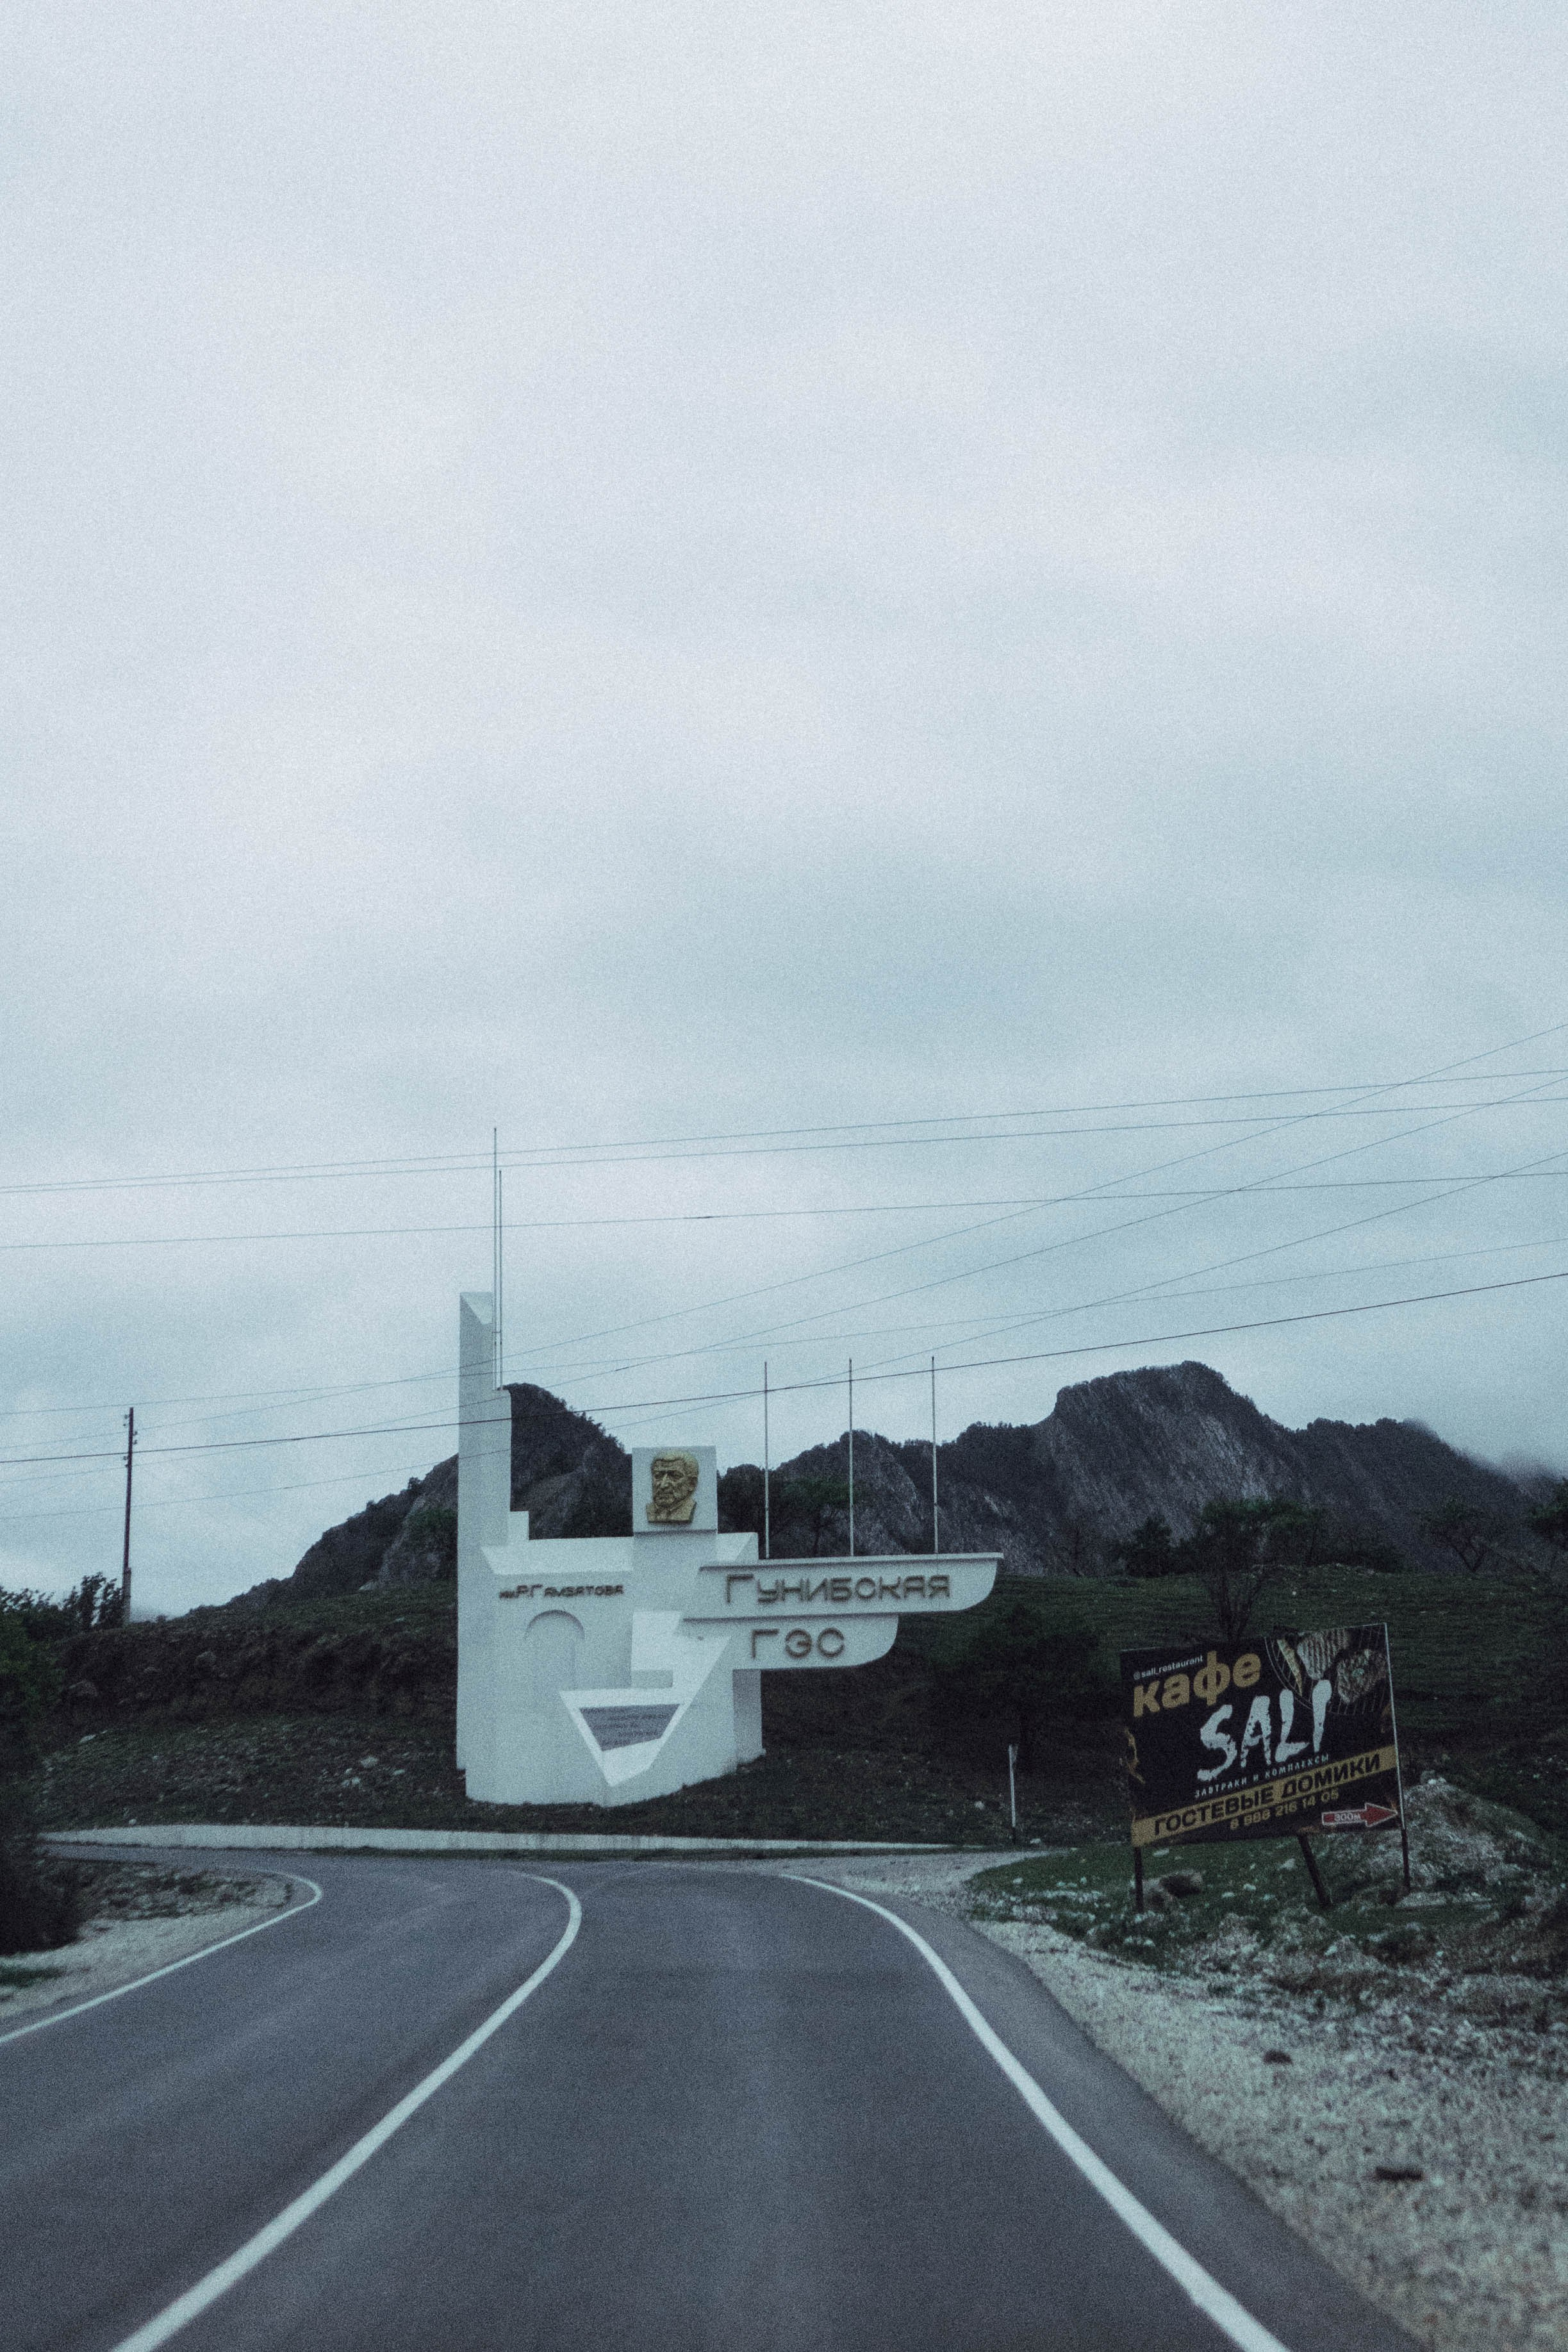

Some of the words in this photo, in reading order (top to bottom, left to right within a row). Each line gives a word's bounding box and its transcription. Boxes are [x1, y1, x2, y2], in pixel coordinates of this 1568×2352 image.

[751, 1628, 845, 1658] ГЭС
[1133, 1650, 1262, 1718] кафе
[1197, 1679, 1332, 1781] SALI
[1153, 1786, 1275, 1834] ГОСТЕВЫЕ
[1281, 1753, 1380, 1798] ДОМИКИ
[1194, 1777, 1248, 1798] ЗАВТРАКИ
[1265, 1753, 1329, 1778] КОМПЛЕКСЫ
[1302, 1796, 1316, 1809] 14
